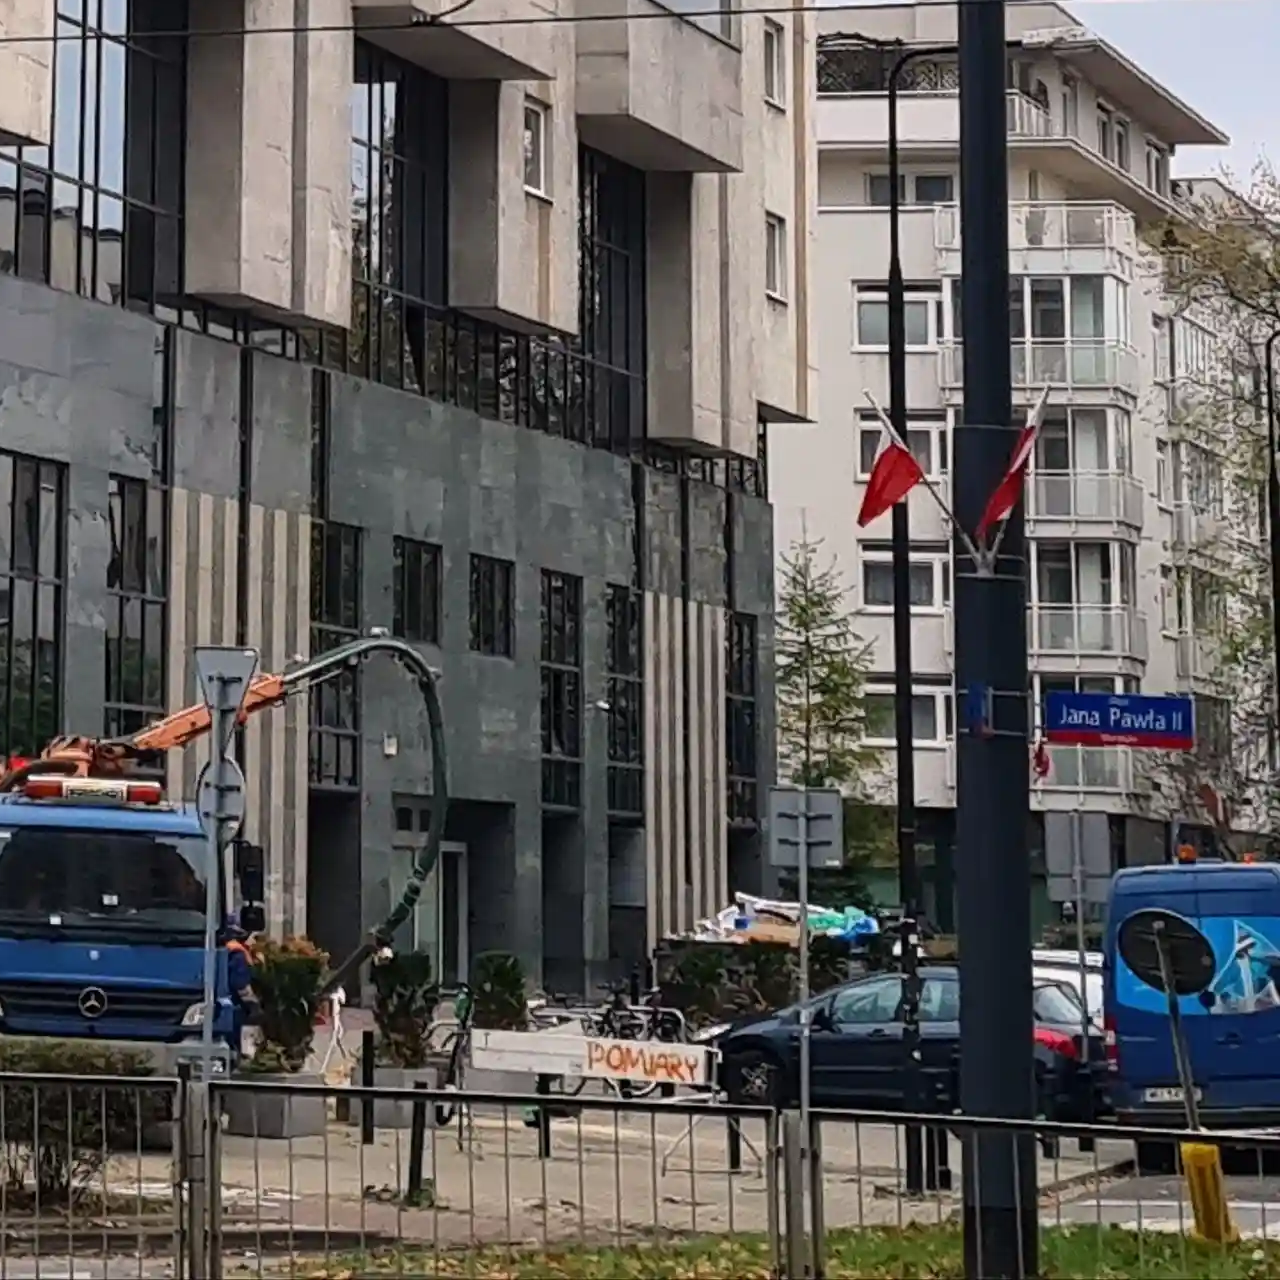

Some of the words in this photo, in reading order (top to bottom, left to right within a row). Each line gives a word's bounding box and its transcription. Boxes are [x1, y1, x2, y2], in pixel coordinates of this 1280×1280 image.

[1060, 704, 1100, 726] Jana
[1109, 707, 1167, 731] Pawła
[1172, 711, 1183, 731] II
